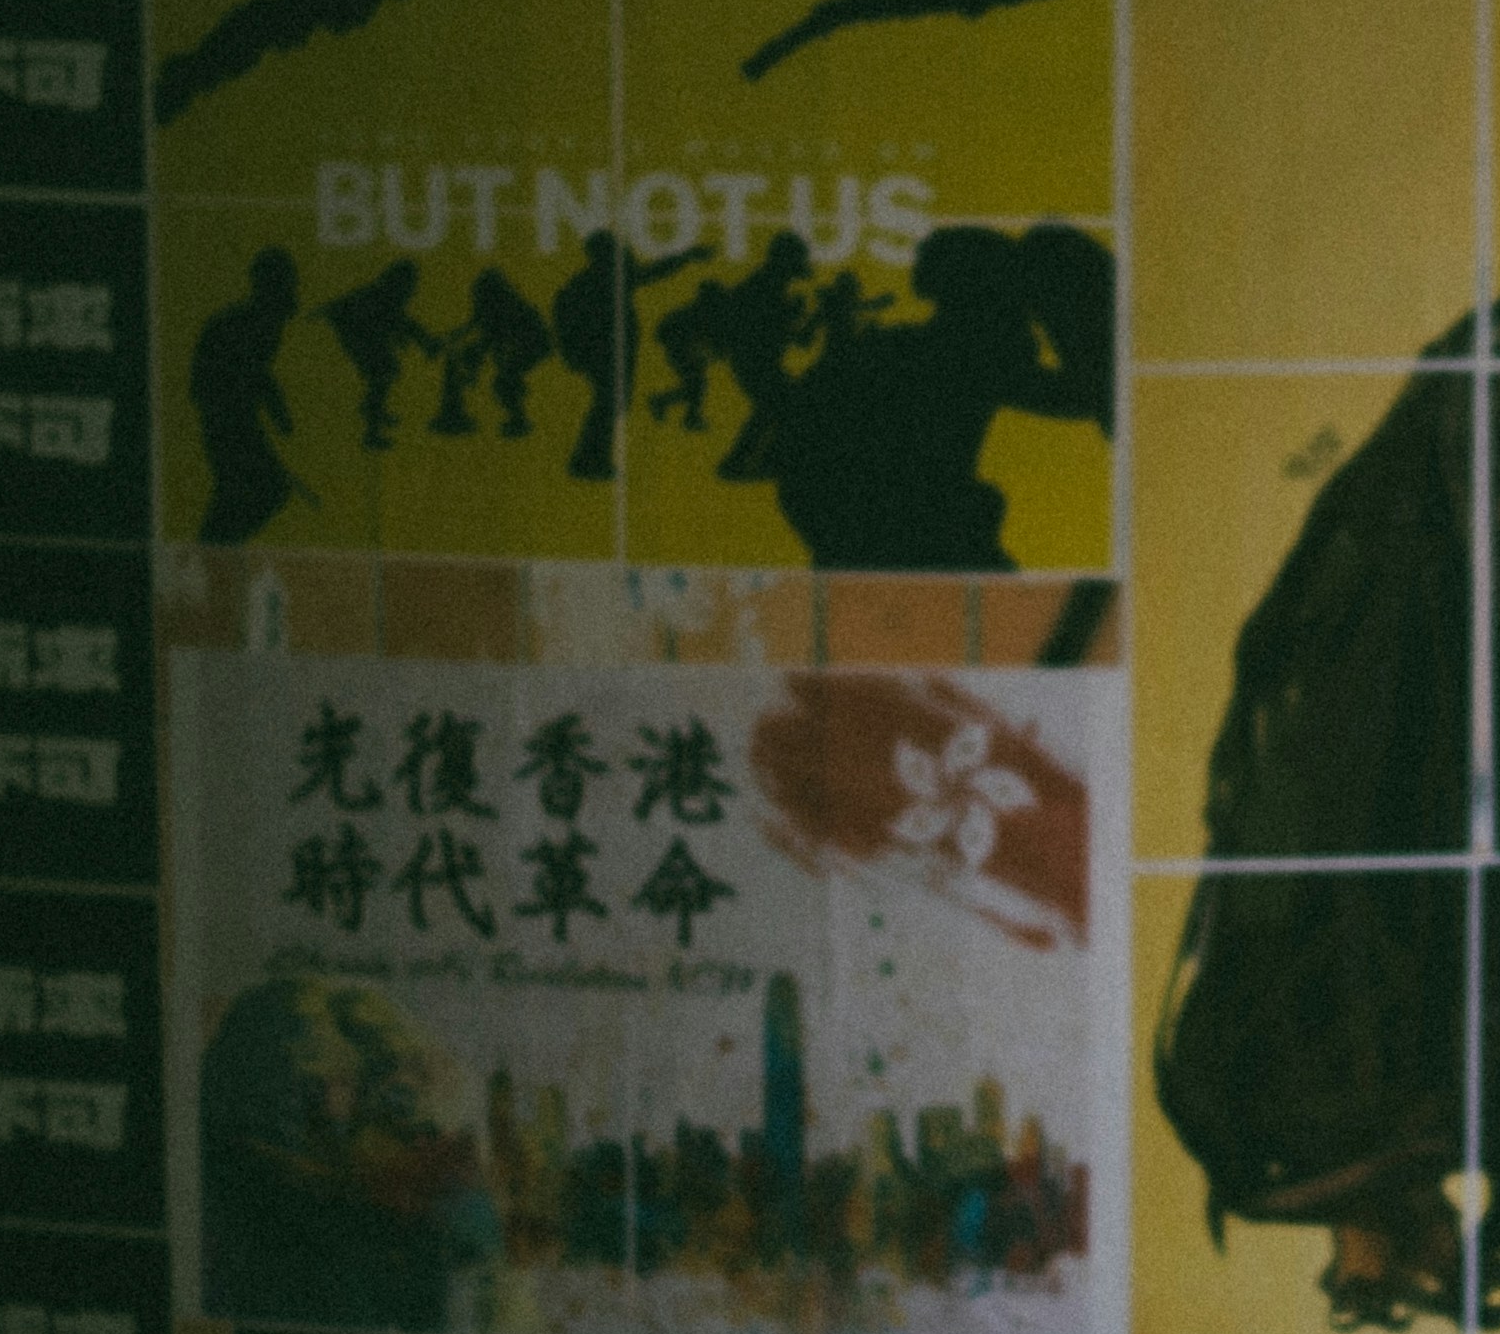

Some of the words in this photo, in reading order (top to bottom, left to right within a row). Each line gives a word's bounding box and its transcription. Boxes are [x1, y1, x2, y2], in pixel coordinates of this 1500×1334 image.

[314, 164, 512, 253] BUT
[536, 169, 768, 263] NOT
[790, 172, 936, 267] US
[288, 699, 738, 824] 光復香港
[281, 822, 738, 949] 時代革命
